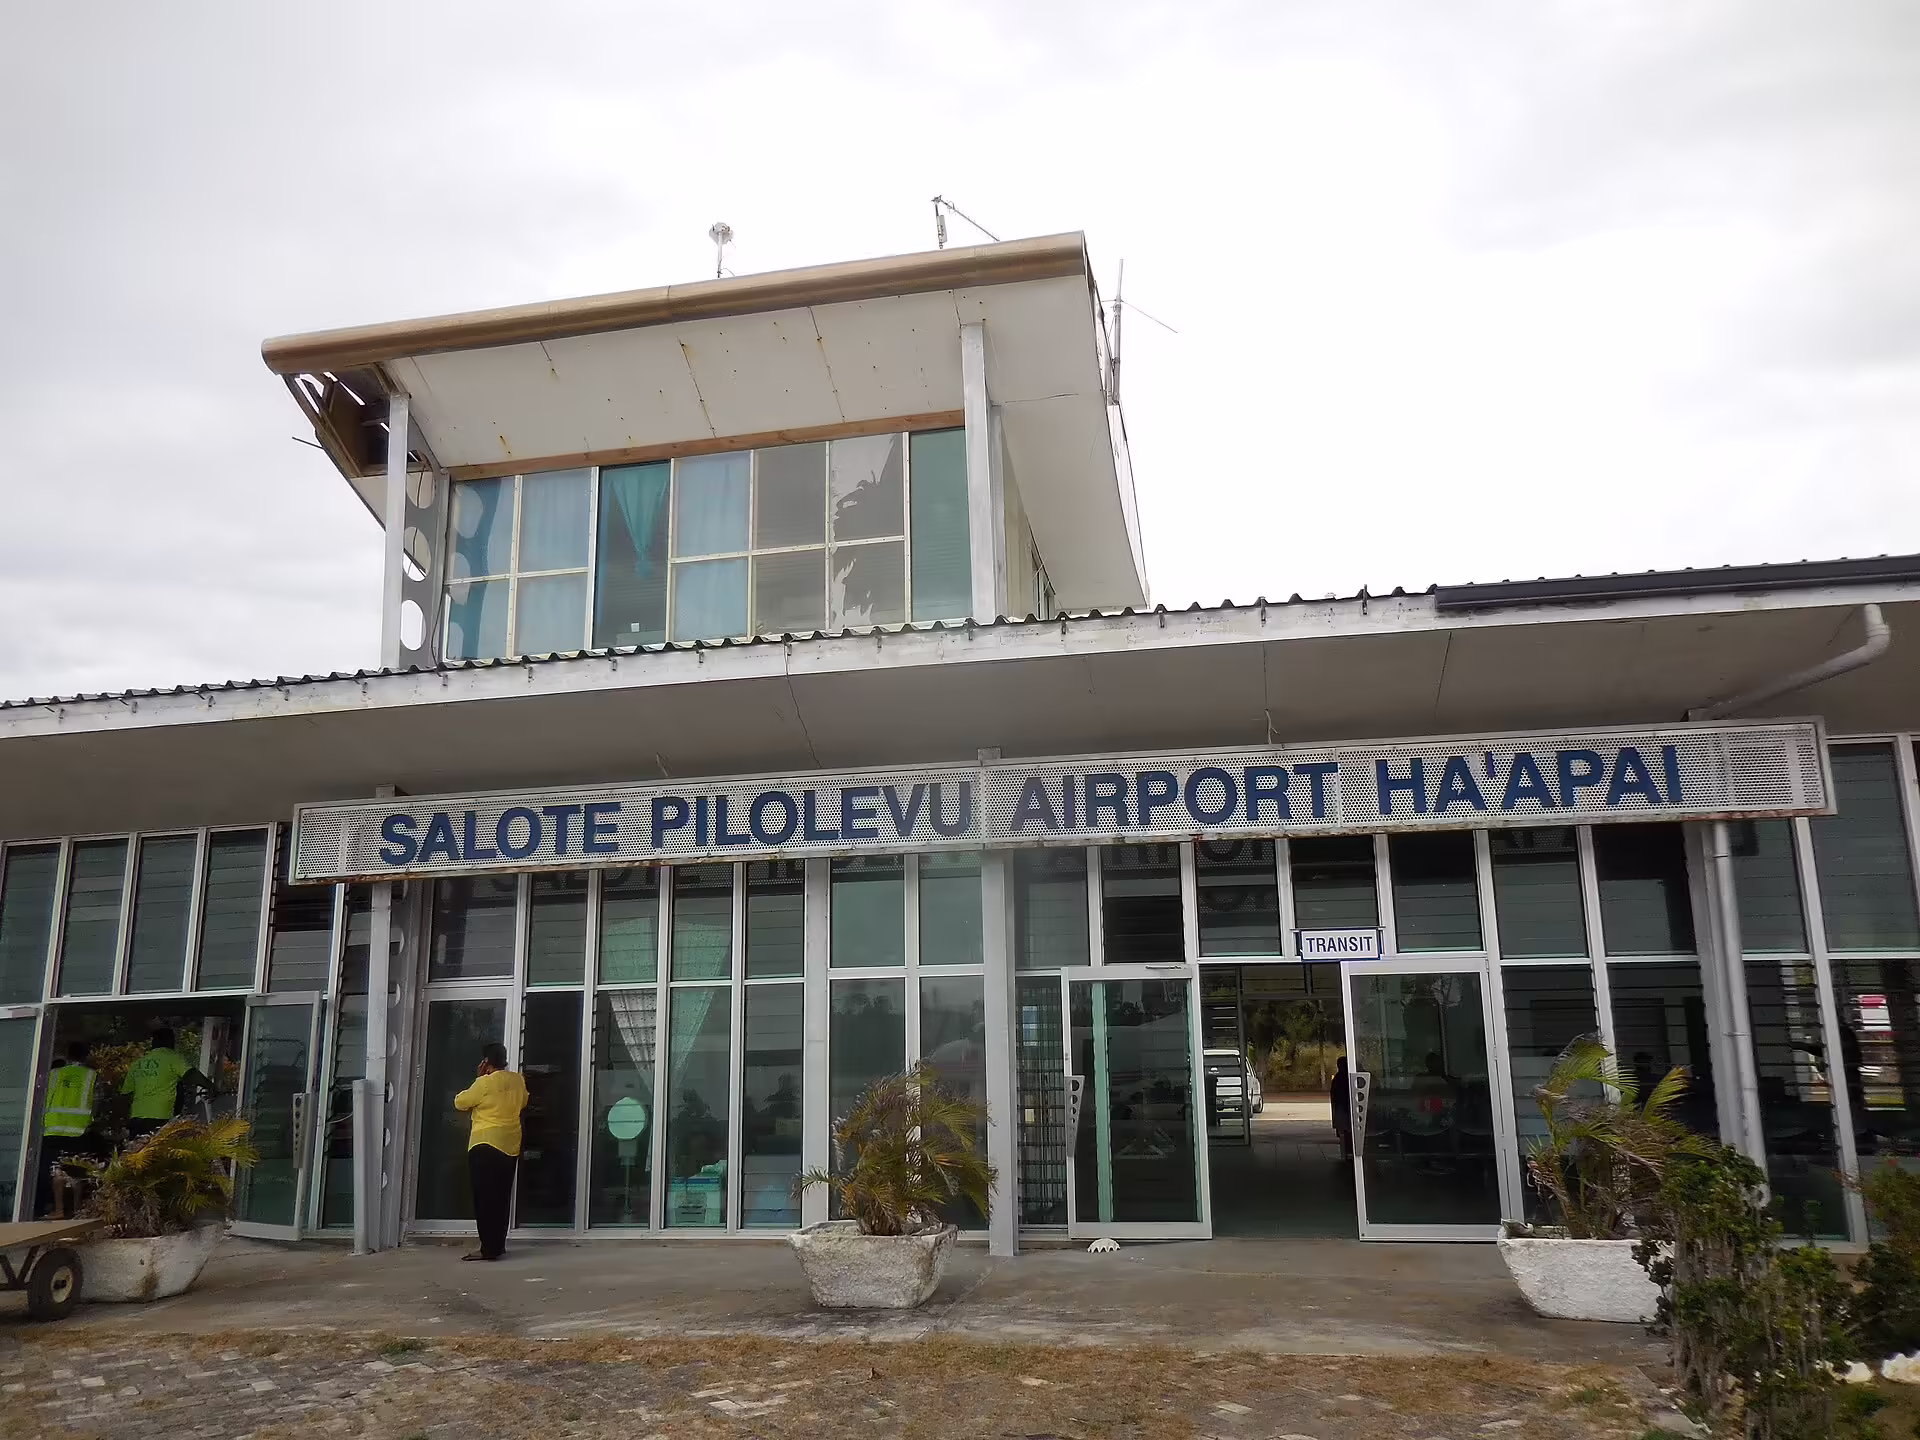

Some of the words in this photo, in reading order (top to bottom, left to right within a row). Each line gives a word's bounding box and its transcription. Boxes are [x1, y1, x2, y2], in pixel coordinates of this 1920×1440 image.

[380, 803, 621, 865] SALOTE
[650, 781, 972, 848] PILOLEVU
[1011, 763, 1340, 829] AIRPORT
[1377, 745, 1684, 815] HA'APAI
[1305, 936, 1373, 953] TRANSIT
